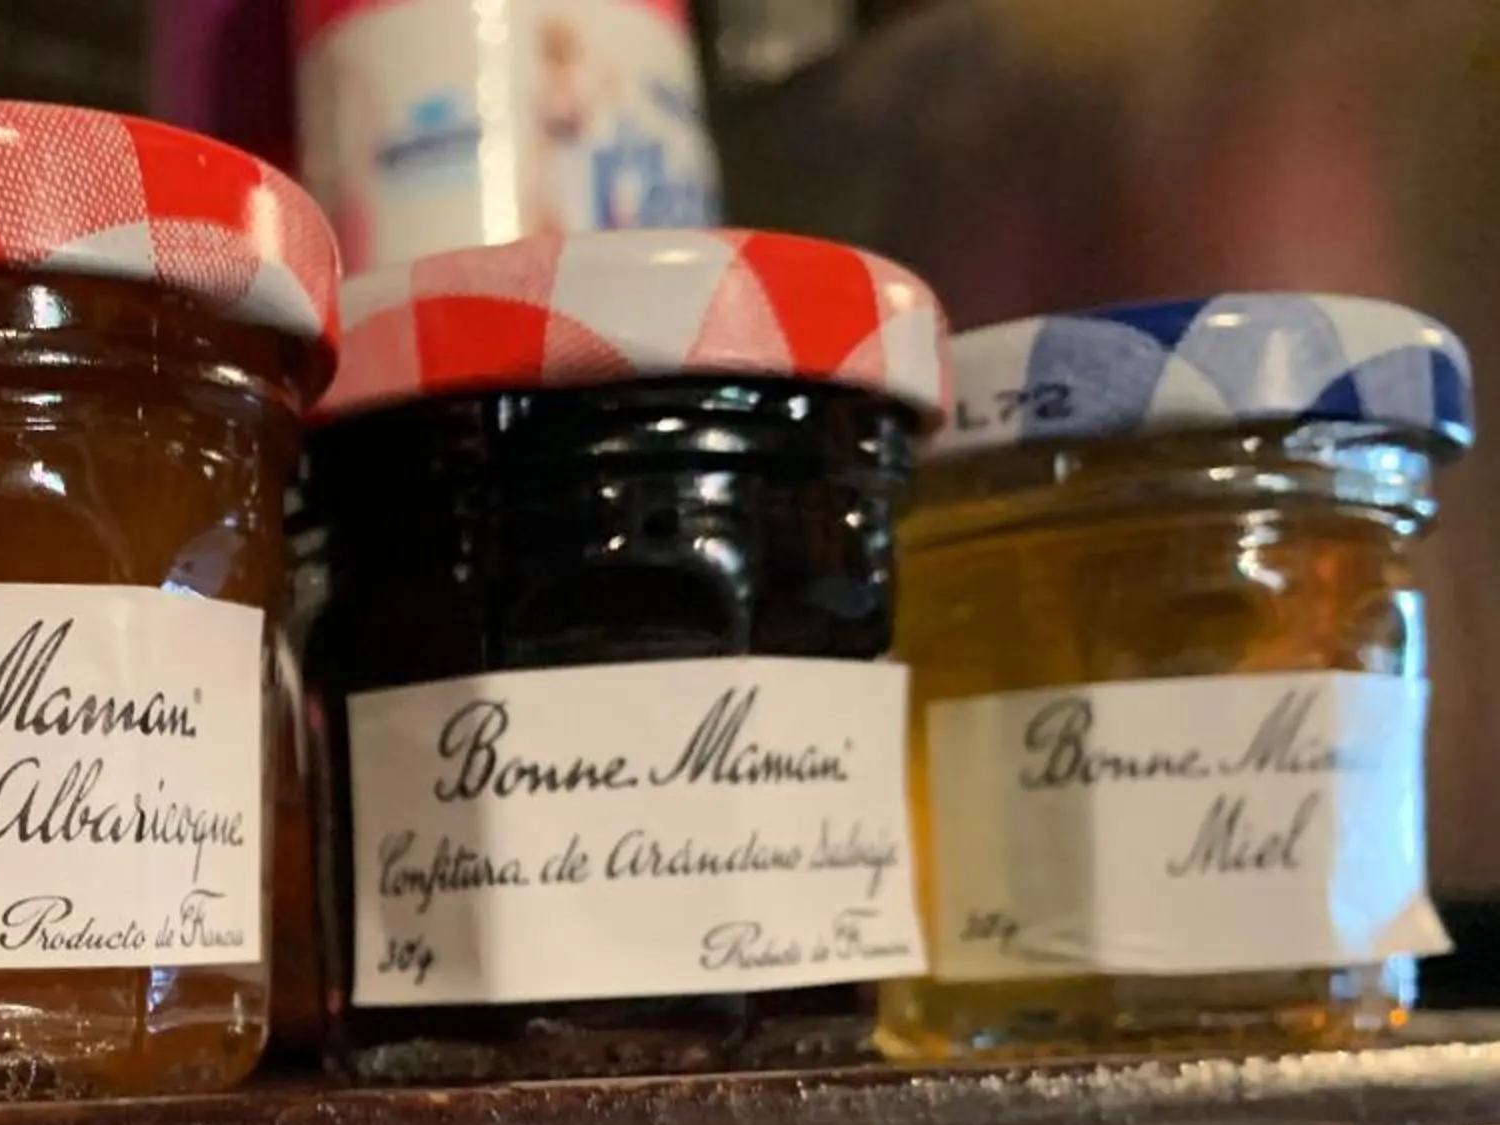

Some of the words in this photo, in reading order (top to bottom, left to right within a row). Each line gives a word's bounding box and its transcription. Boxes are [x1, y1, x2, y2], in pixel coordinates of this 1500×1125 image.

[434, 698, 639, 802] Bonne
[1018, 697, 1211, 791] Bonne
[378, 831, 529, 915] Confitura
[540, 833, 589, 885] de
[1166, 792, 1320, 879] Miel
[155, 914, 175, 949] de
